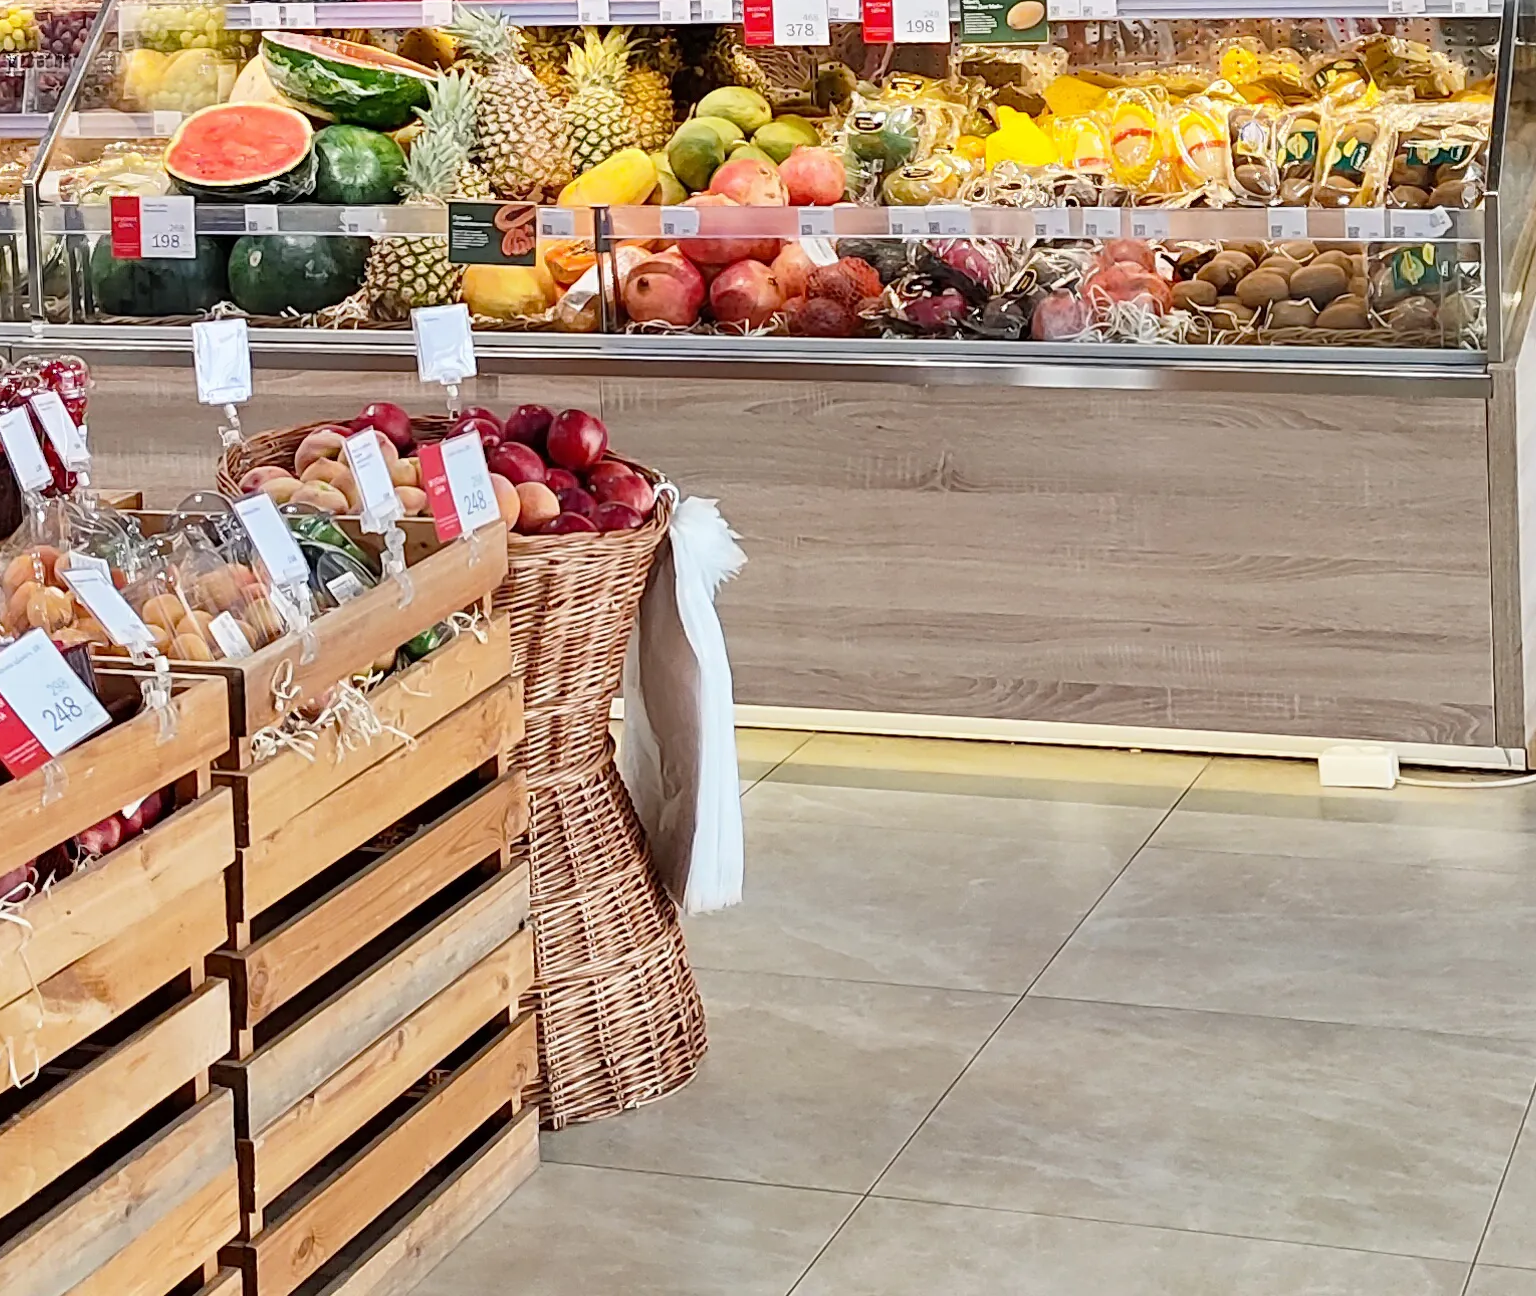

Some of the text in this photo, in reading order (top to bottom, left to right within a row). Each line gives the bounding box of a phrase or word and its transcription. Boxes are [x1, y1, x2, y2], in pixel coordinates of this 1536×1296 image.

[785, 23, 814, 37] 378
[906, 19, 935, 33] 198
[151, 234, 180, 248] 198
[464, 489, 487, 515] 248
[42, 696, 83, 732] 248
